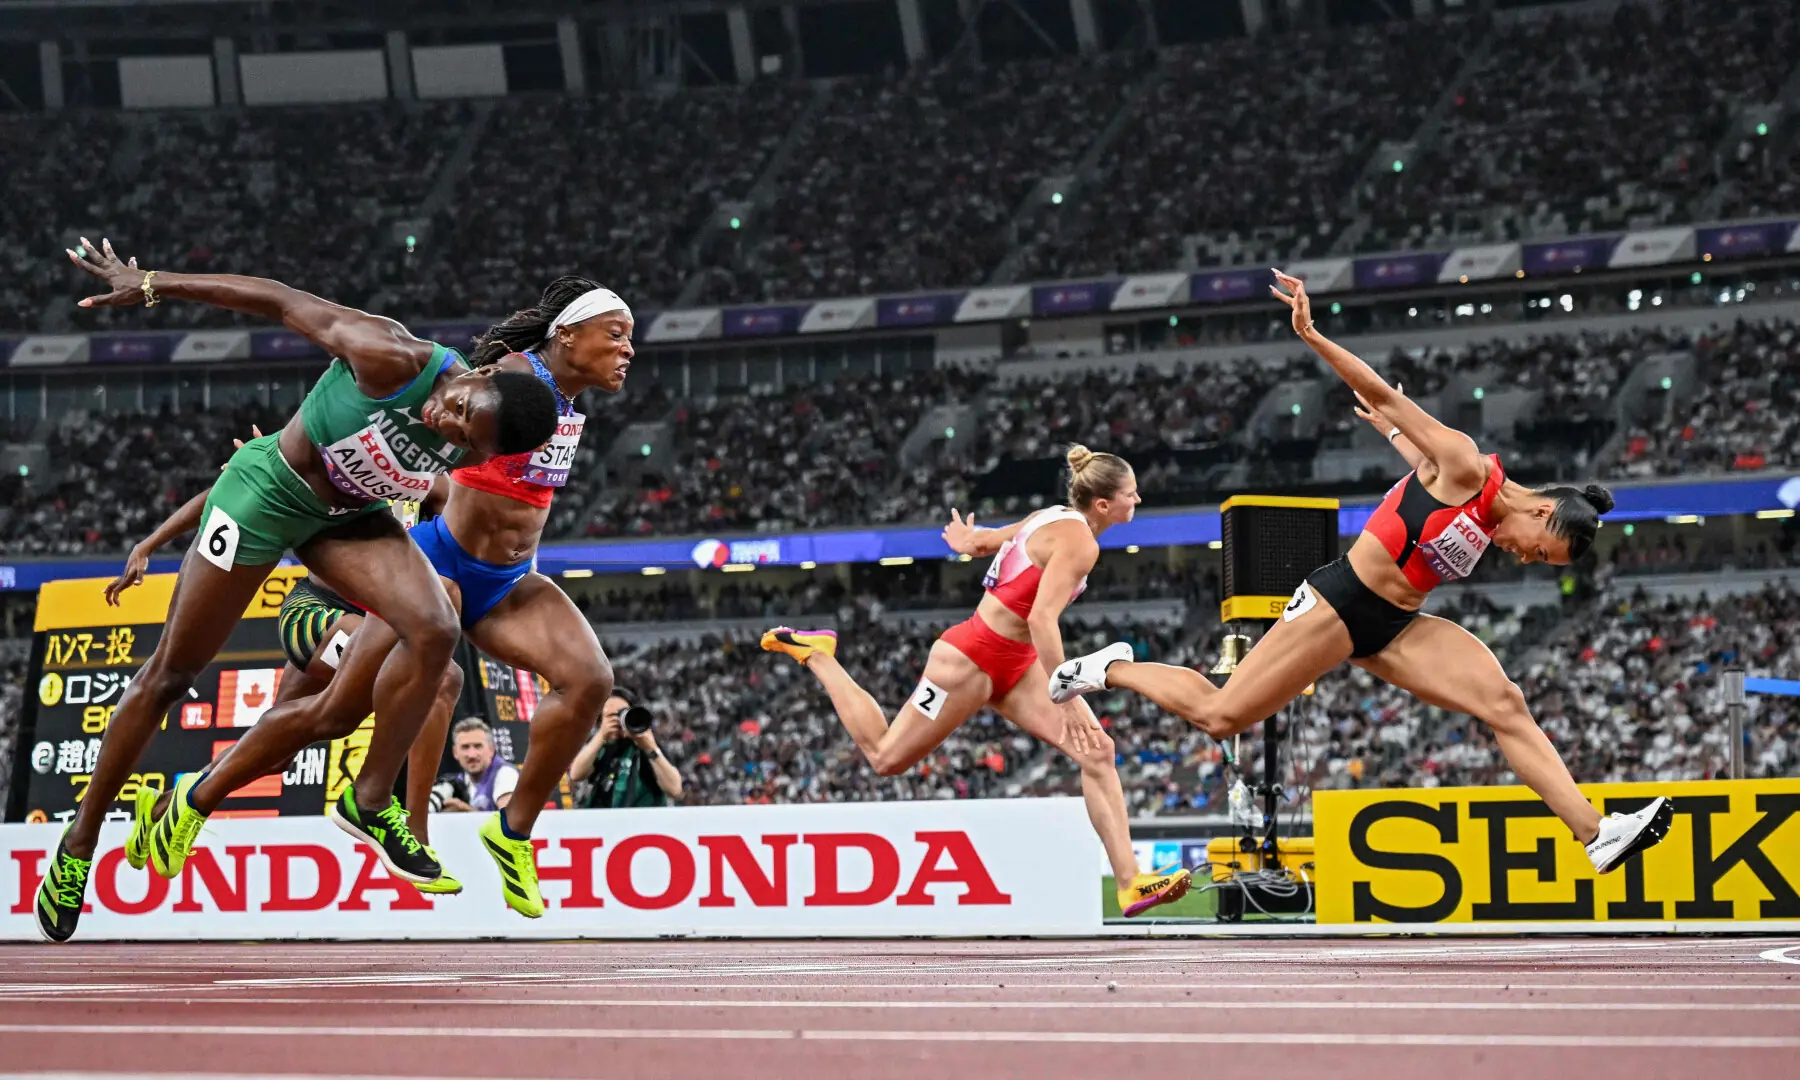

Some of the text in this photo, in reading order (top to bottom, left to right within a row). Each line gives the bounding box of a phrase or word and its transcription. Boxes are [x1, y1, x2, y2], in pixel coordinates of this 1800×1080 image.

[358, 430, 430, 491] HONDA
[209, 524, 230, 557] 6
[45, 628, 135, 665] ハンマー投
[918, 687, 936, 712] 2
[1595, 837, 1621, 850] RUNNING
[10, 843, 434, 915] HONDA
[507, 831, 1012, 910] HONDA
[1138, 878, 1170, 896] NITRO
